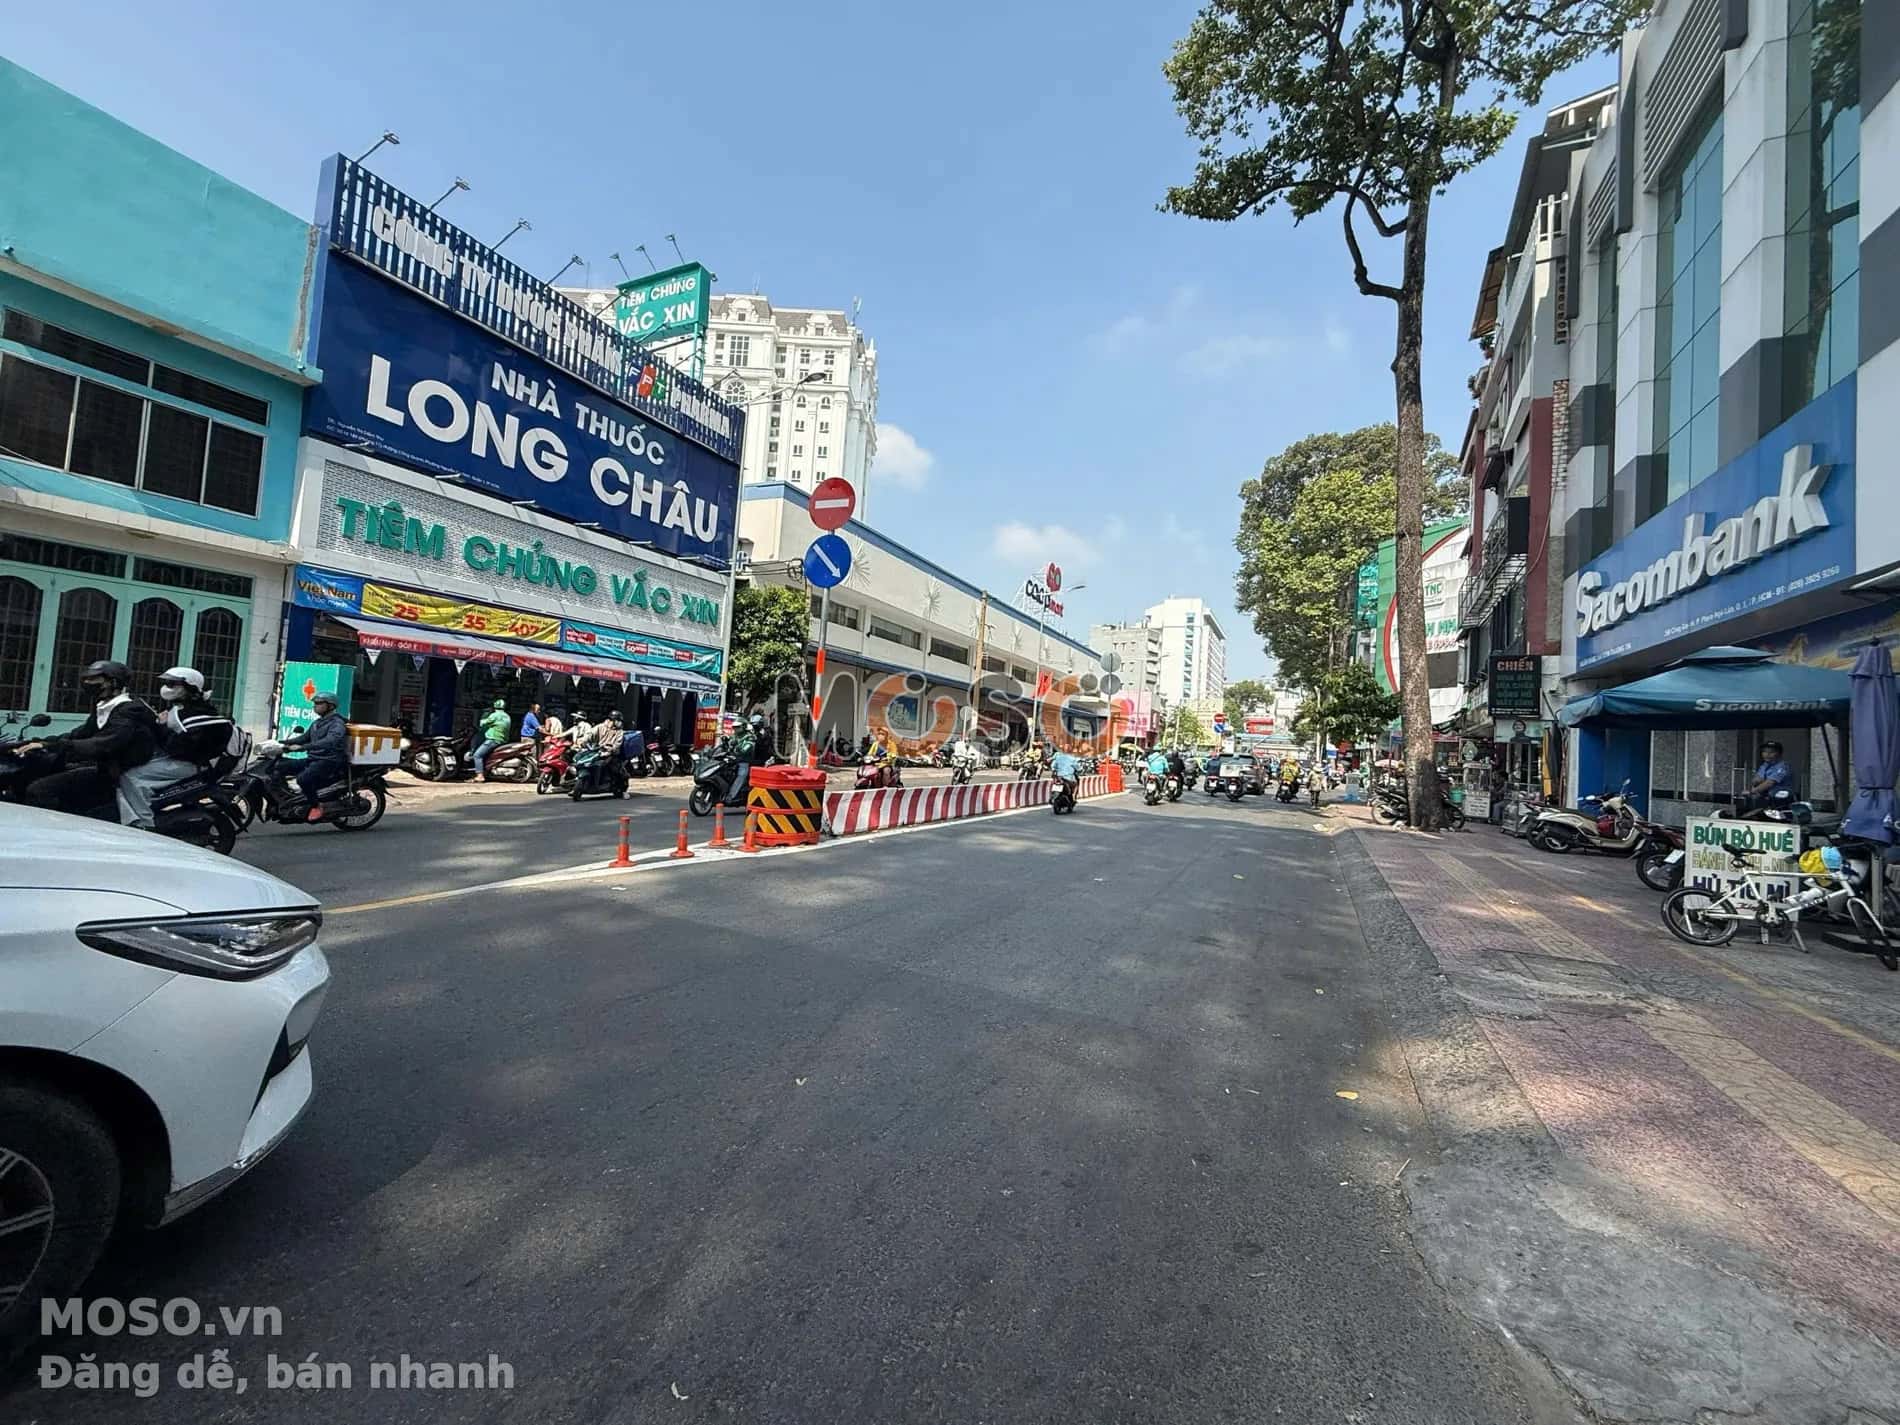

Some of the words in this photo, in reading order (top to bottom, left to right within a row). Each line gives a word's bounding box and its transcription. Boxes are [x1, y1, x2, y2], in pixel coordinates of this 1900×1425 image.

[650, 277, 696, 300] CHỦNG
[372, 204, 454, 280] CÔNG
[459, 255, 492, 298] TY
[496, 278, 561, 342] DƯỢC
[628, 361, 667, 398] FPT
[670, 386, 731, 439] PHARMA
[619, 307, 655, 335] VẮC
[663, 300, 695, 324] XIN
[491, 361, 561, 419] NHÀ
[575, 402, 666, 465] THUỐC
[366, 354, 569, 483] LONG
[590, 456, 719, 543] CHÂU
[1576, 443, 1834, 638] Sacombank
[336, 496, 446, 561] TIÊM
[463, 536, 597, 596] CHỦNG
[611, 567, 672, 614] VẮC
[680, 594, 720, 627] XIN
[327, 586, 356, 601] Nam
[1694, 698, 1833, 713] Sacombank
[1693, 822, 1728, 847] BÚN
[1730, 825, 1756, 849] BÒ
[1691, 847, 1726, 871] BÁNH
[1766, 880, 1791, 902] MÌ
